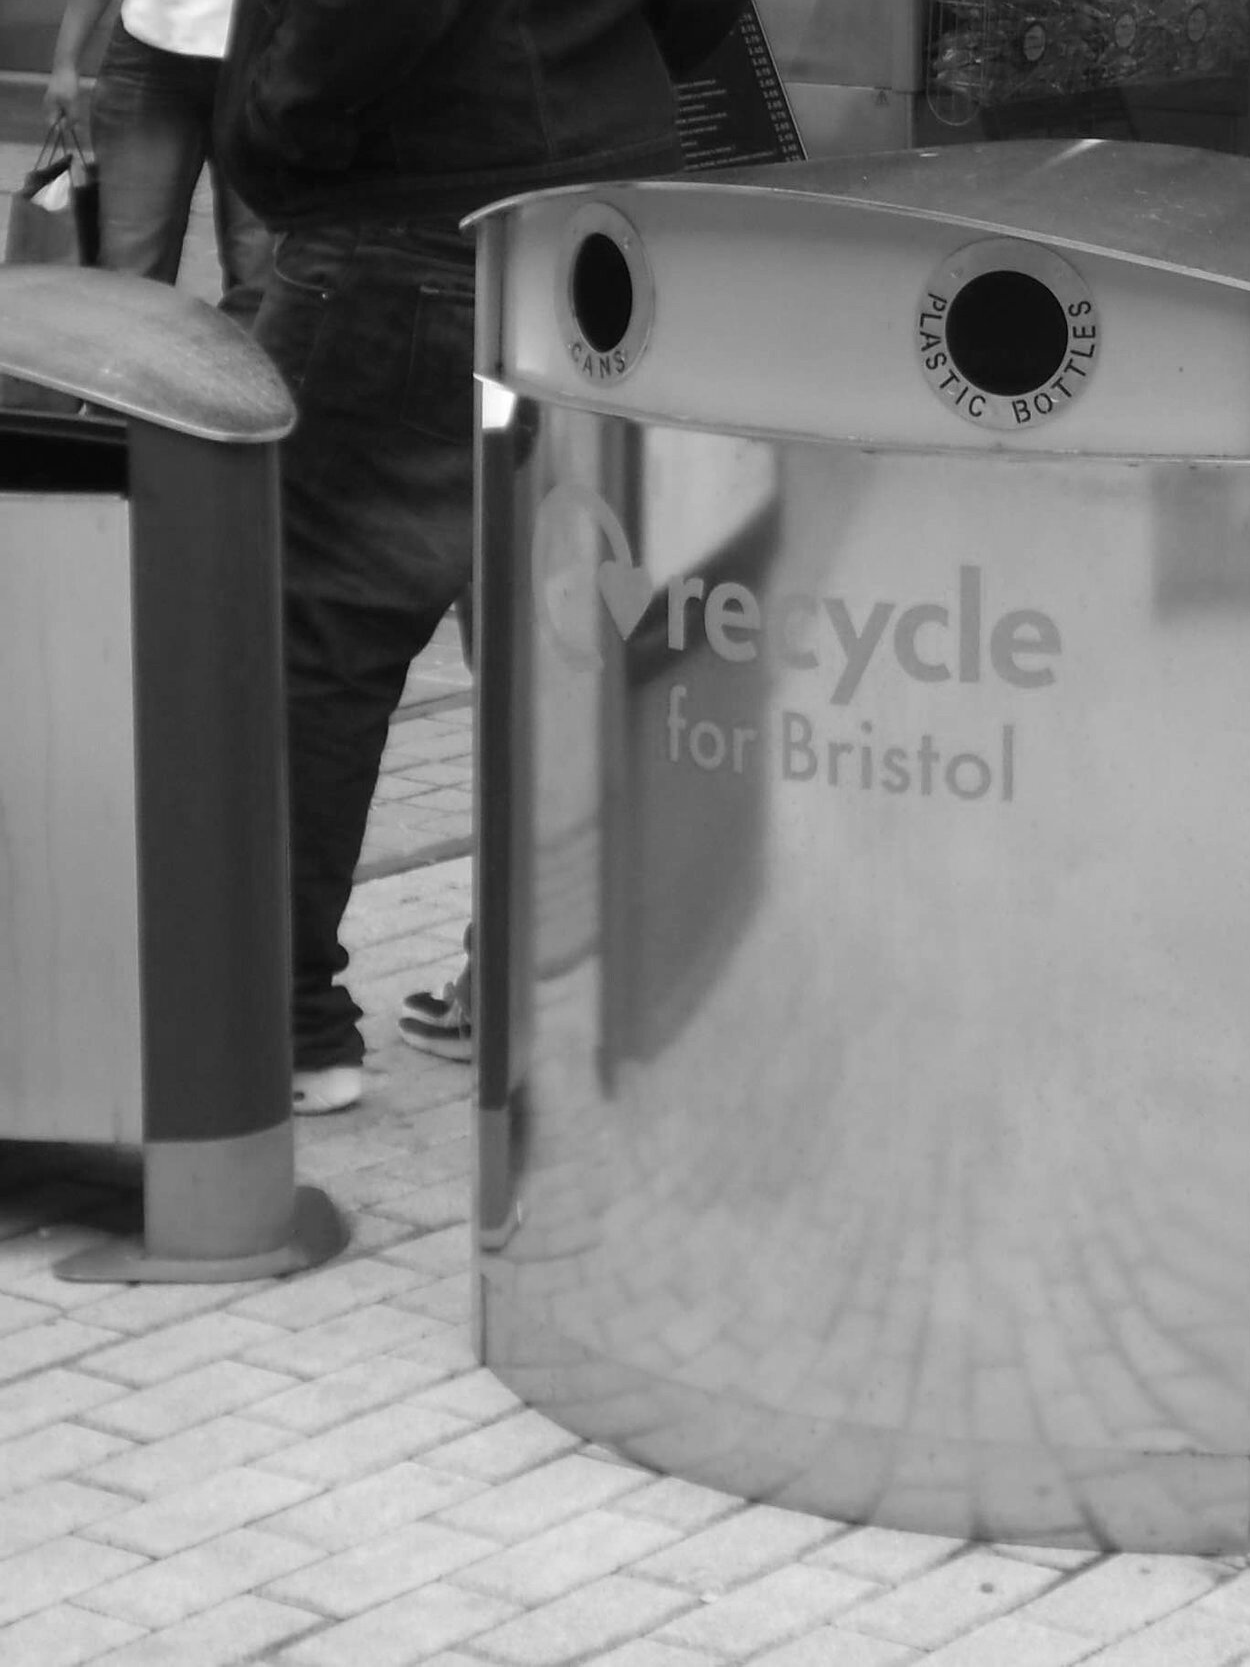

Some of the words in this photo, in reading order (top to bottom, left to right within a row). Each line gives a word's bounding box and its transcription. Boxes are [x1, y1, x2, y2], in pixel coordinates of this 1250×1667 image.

[571, 343, 626, 379] CANS
[919, 292, 987, 418] PLASTIC
[1012, 300, 1096, 424] BOTTLES
[666, 564, 1063, 706] recycle
[666, 684, 757, 774] for
[781, 710, 1015, 803] Bristol
